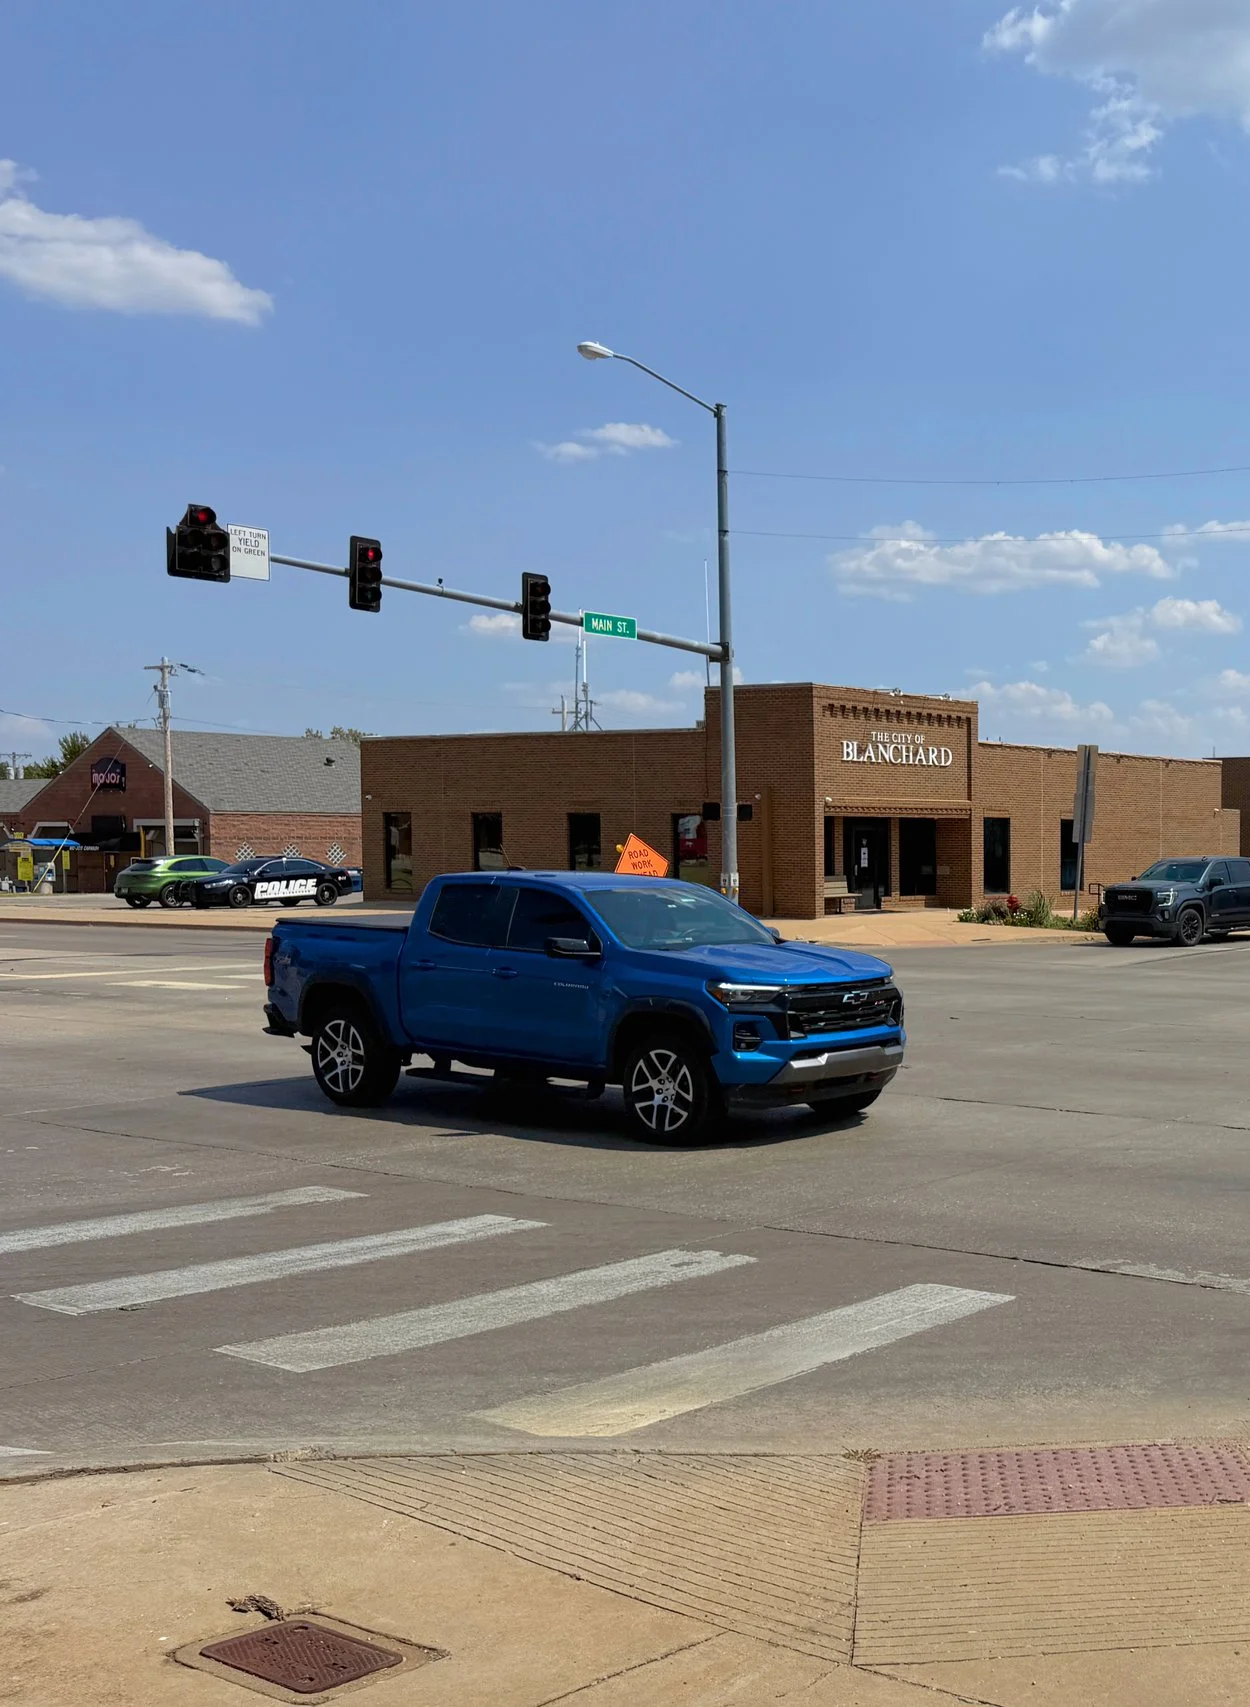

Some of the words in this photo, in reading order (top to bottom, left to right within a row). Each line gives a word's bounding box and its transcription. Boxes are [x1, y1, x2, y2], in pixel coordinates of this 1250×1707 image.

[230, 529, 247, 537] LEFT
[249, 531, 267, 540] TURN
[238, 537, 260, 548] YIELD
[243, 547, 266, 557] GREEN
[591, 617, 613, 632] MAIN
[617, 621, 630, 634] ST.
[871, 731, 890, 743] THE
[892, 733, 912, 744] CITY
[914, 734, 926, 745] OF
[840, 740, 953, 768] BLANCHARD
[627, 848, 649, 861] ROAD
[630, 859, 654, 871] WORK
[254, 878, 318, 899] POLICE
